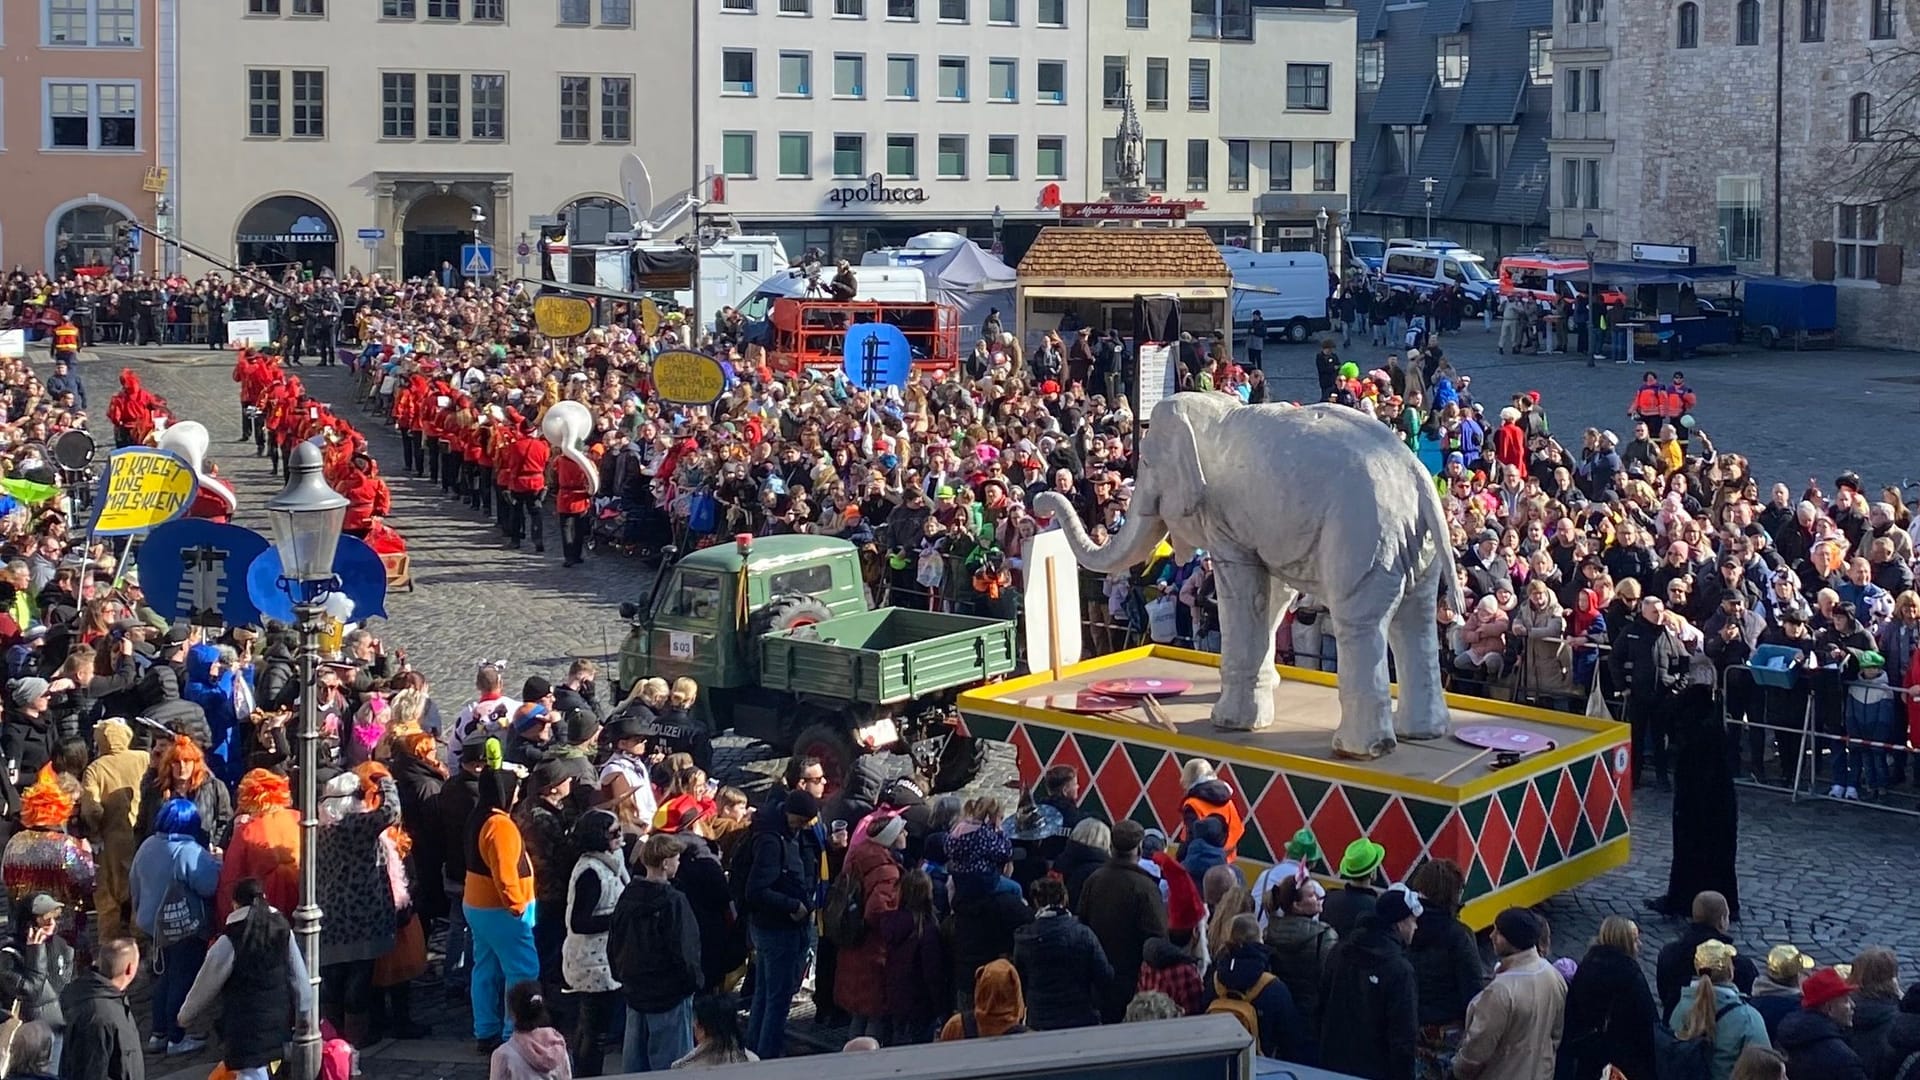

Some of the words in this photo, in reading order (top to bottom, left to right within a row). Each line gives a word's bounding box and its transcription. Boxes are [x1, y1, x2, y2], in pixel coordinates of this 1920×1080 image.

[827, 172, 930, 208] apotheca
[127, 455, 187, 482] KRIEGT
[114, 477, 143, 491] UNS
